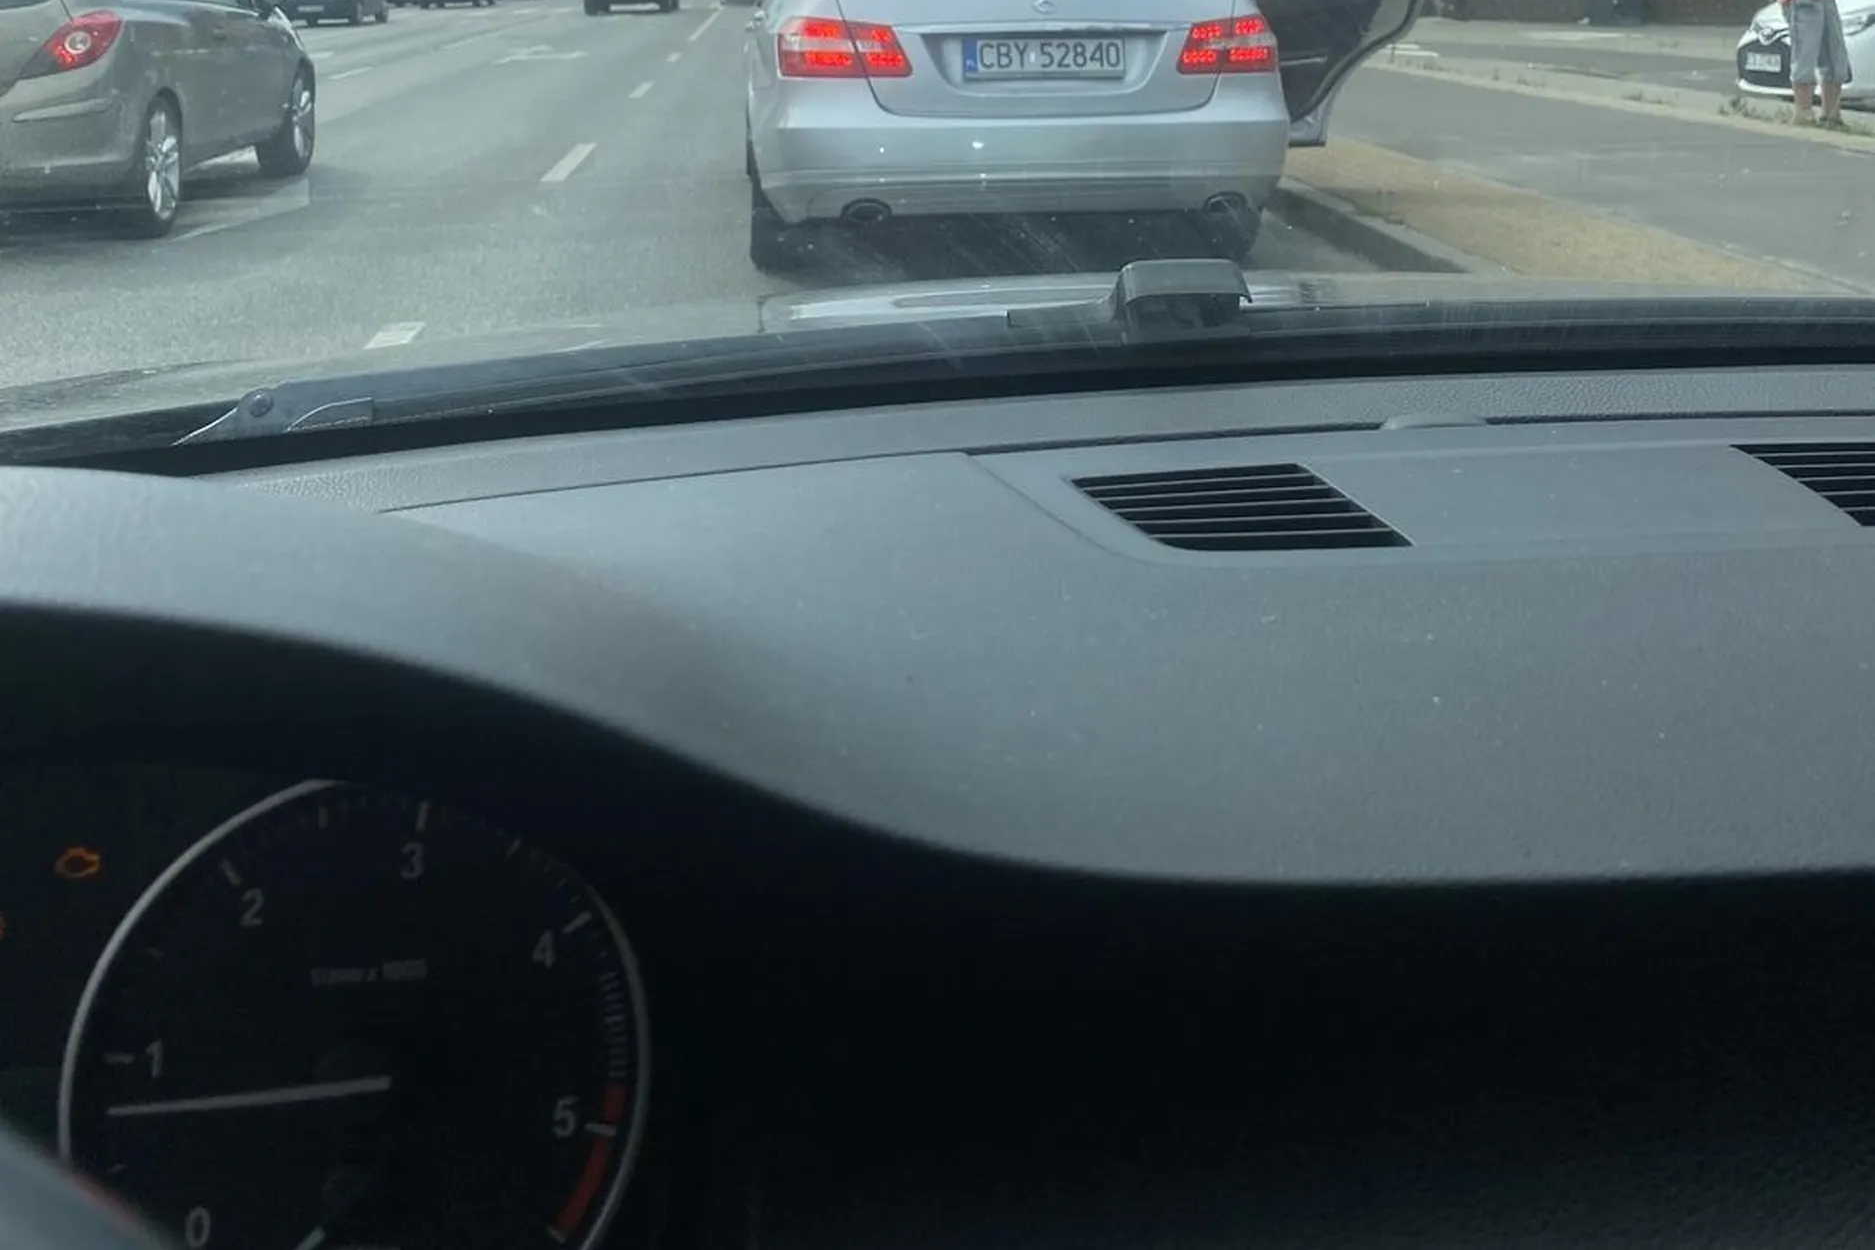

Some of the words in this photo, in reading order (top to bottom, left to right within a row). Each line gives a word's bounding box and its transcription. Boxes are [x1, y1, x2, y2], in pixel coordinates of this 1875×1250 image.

[979, 42, 1028, 69] CBY
[1039, 42, 1120, 69] 52840
[401, 841, 425, 880] 3
[241, 888, 265, 927] 2
[531, 929, 557, 968] 4
[145, 1038, 163, 1079] 1
[553, 1095, 579, 1138] 5
[184, 1206, 211, 1247] 0
